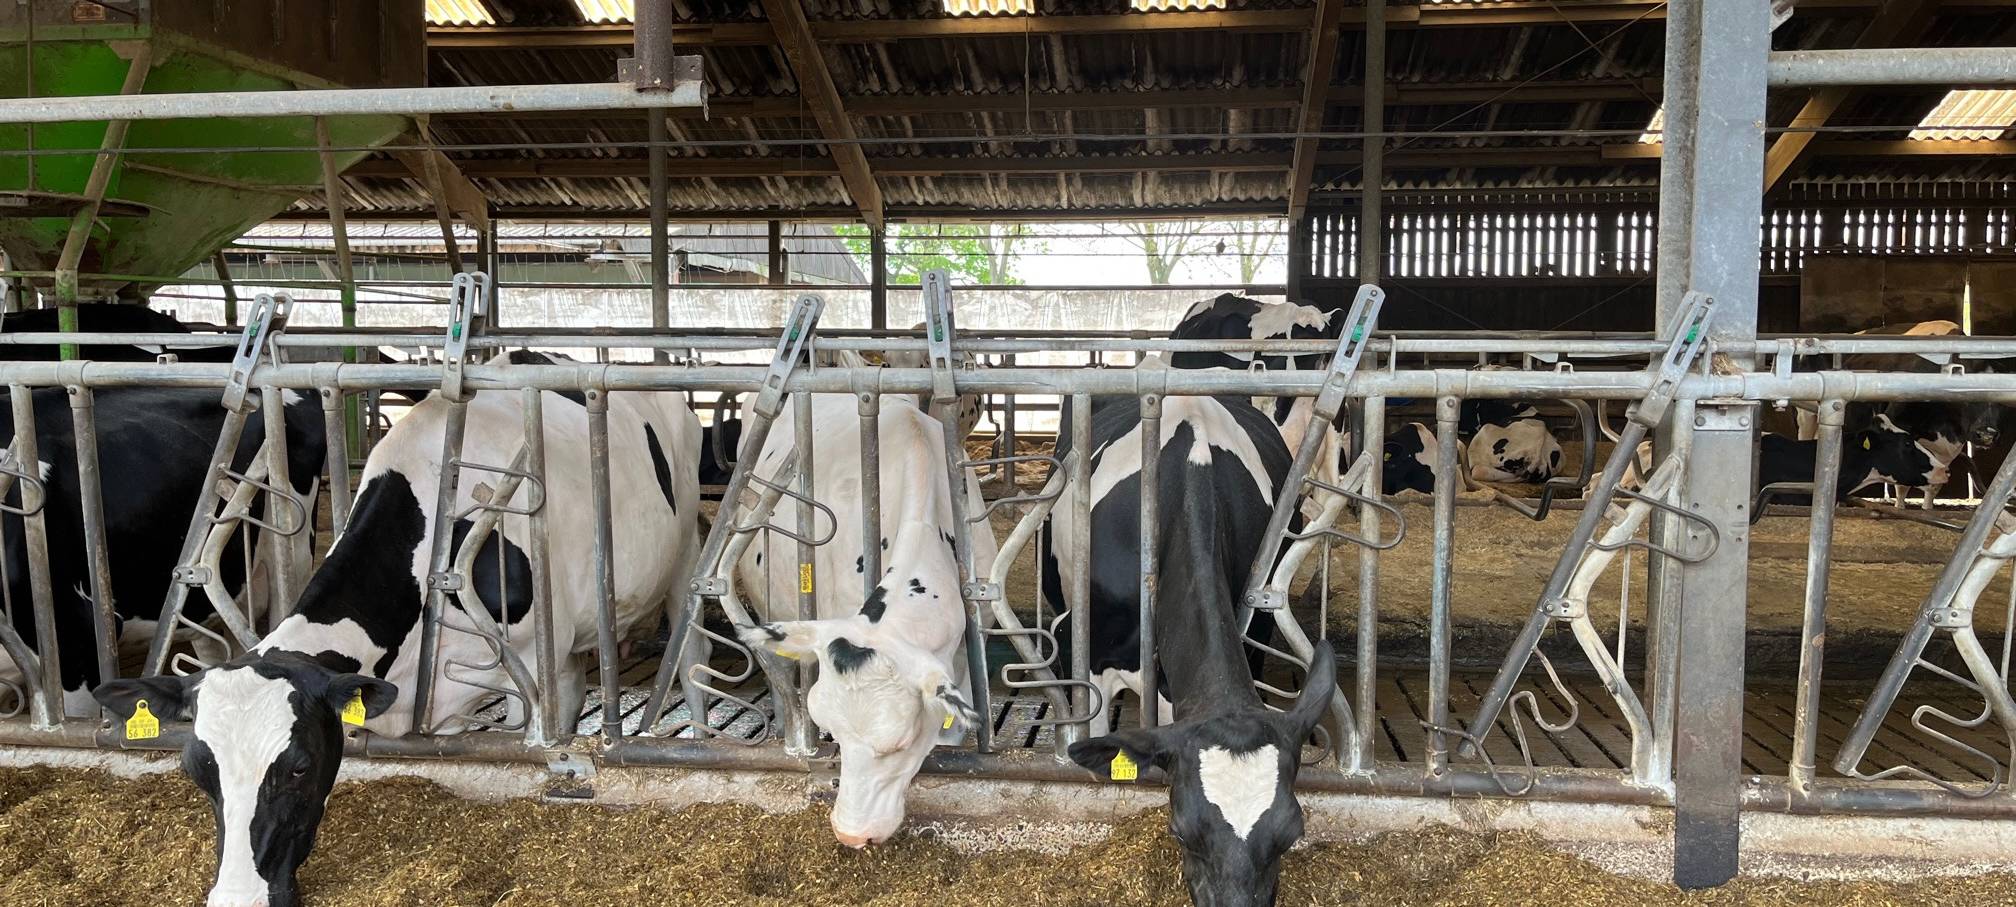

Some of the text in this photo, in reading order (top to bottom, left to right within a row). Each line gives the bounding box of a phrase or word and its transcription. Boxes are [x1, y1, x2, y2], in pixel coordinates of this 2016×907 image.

[128, 727, 157, 739] 56 382
[1123, 768, 1136, 779] 132
